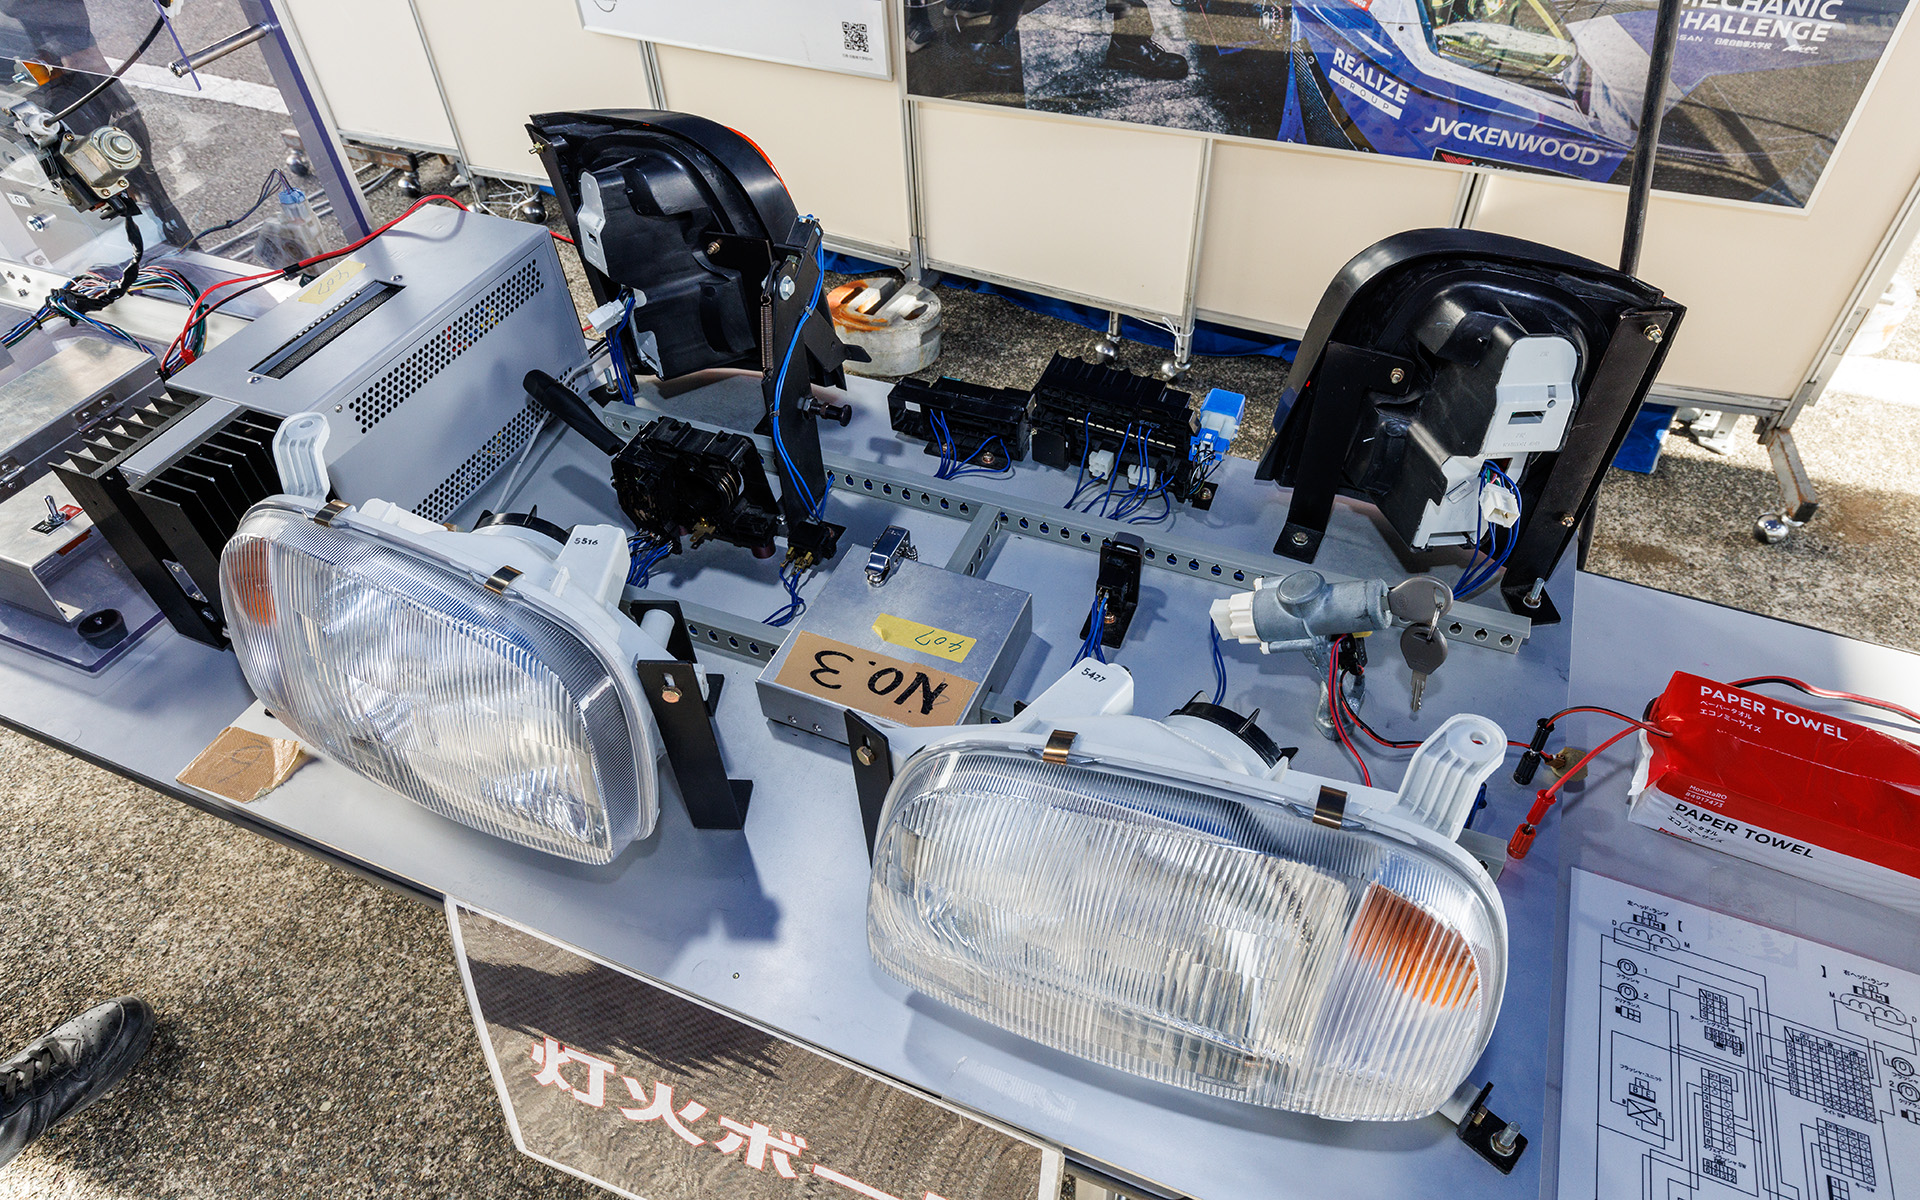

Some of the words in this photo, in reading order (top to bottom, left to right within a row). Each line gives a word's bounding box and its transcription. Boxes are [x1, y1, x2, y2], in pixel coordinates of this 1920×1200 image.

[1680, 10, 1832, 42] HALLENGE
[1687, 0, 1844, 20] ECHANIC
[1332, 47, 1410, 105] REALIZE
[1339, 76, 1390, 111] GROUP
[1424, 116, 1600, 166] JVCKENWOOD
[574, 537, 599, 546] 5516
[1081, 667, 1107, 683] 5427
[1700, 700, 1752, 720] ペーパータオル
[1700, 709, 1762, 733] エコノミーサイズ
[1701, 686, 1766, 715] PAPER
[1772, 707, 1848, 741] TOWEL
[1689, 785, 1727, 800] MonotaRO
[1675, 803, 1738, 834] PAPER
[1745, 828, 1814, 859] TOWEL
[531, 1036, 952, 1200] 灯火ボー
